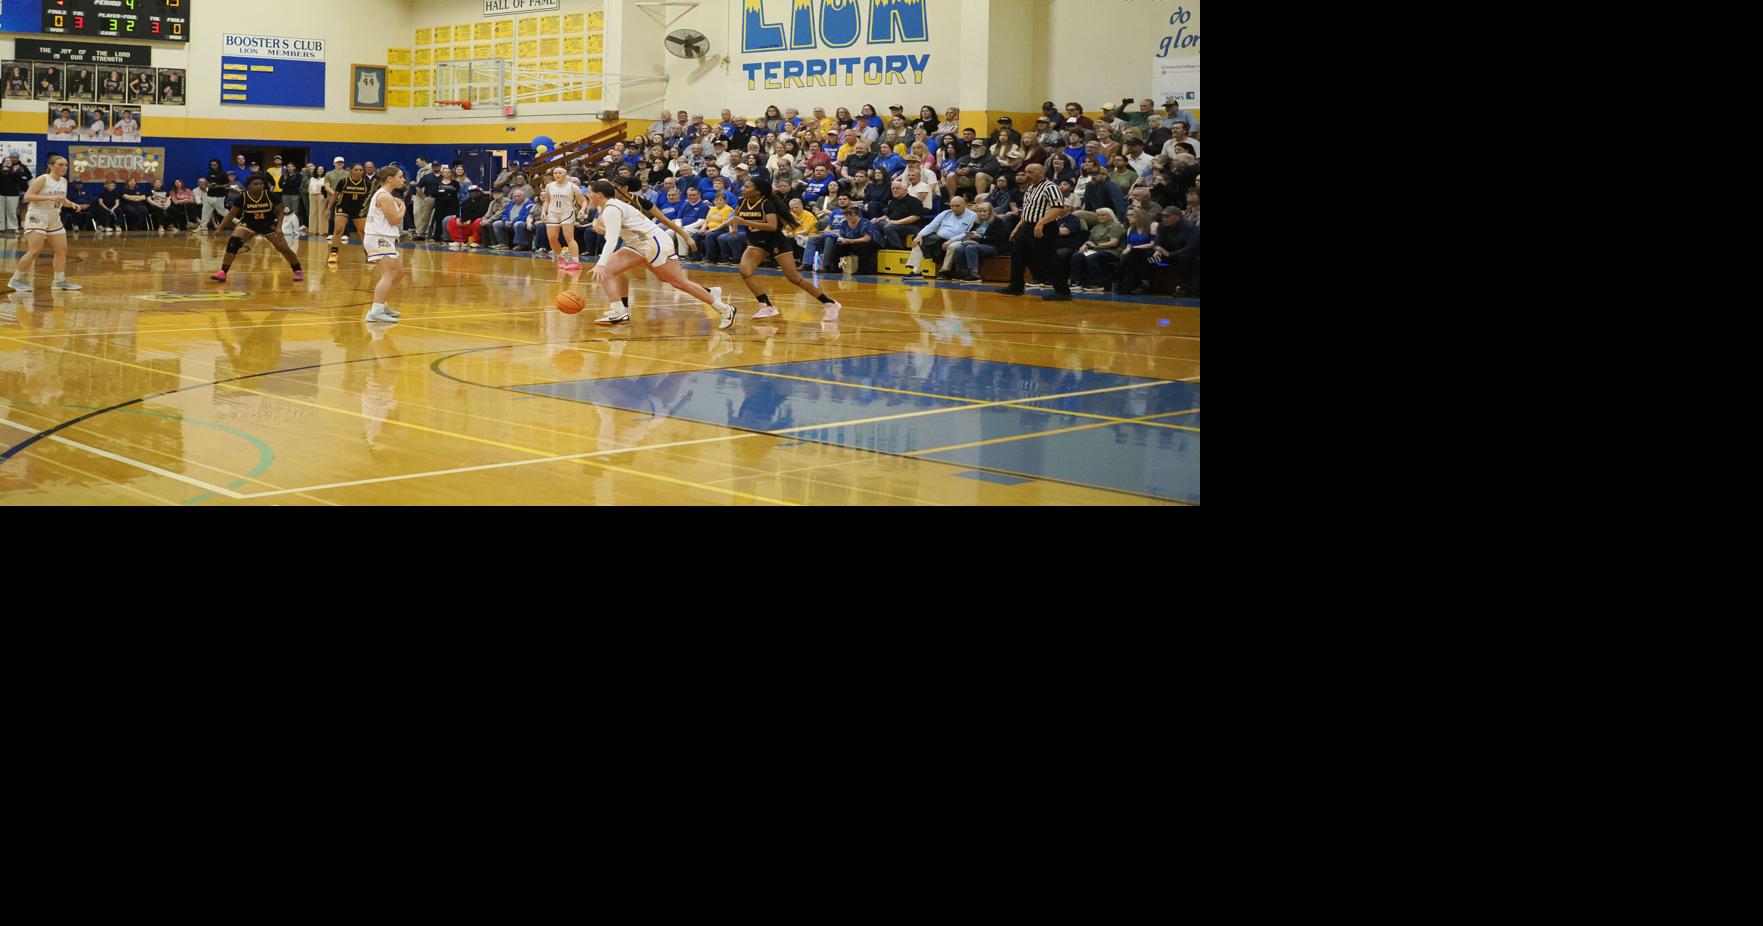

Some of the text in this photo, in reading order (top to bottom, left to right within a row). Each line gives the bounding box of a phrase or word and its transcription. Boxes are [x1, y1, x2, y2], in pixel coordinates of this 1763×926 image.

[125, 0, 134, 10] 4
[485, 0, 509, 11] HALL
[513, 0, 525, 8] OF
[54, 15, 63, 27] 0
[1169, 6, 1191, 25] do
[74, 16, 84, 29] 3
[151, 22, 160, 33] 3
[173, 23, 182, 35] 0
[293, 40, 322, 51] CLUB
[91, 55, 123, 63] STRENGTH
[267, 49, 315, 58] MEMBERS
[742, 54, 930, 91] TERRITORY
[363, 77, 375, 87] 44
[86, 154, 144, 171] SENIOR
